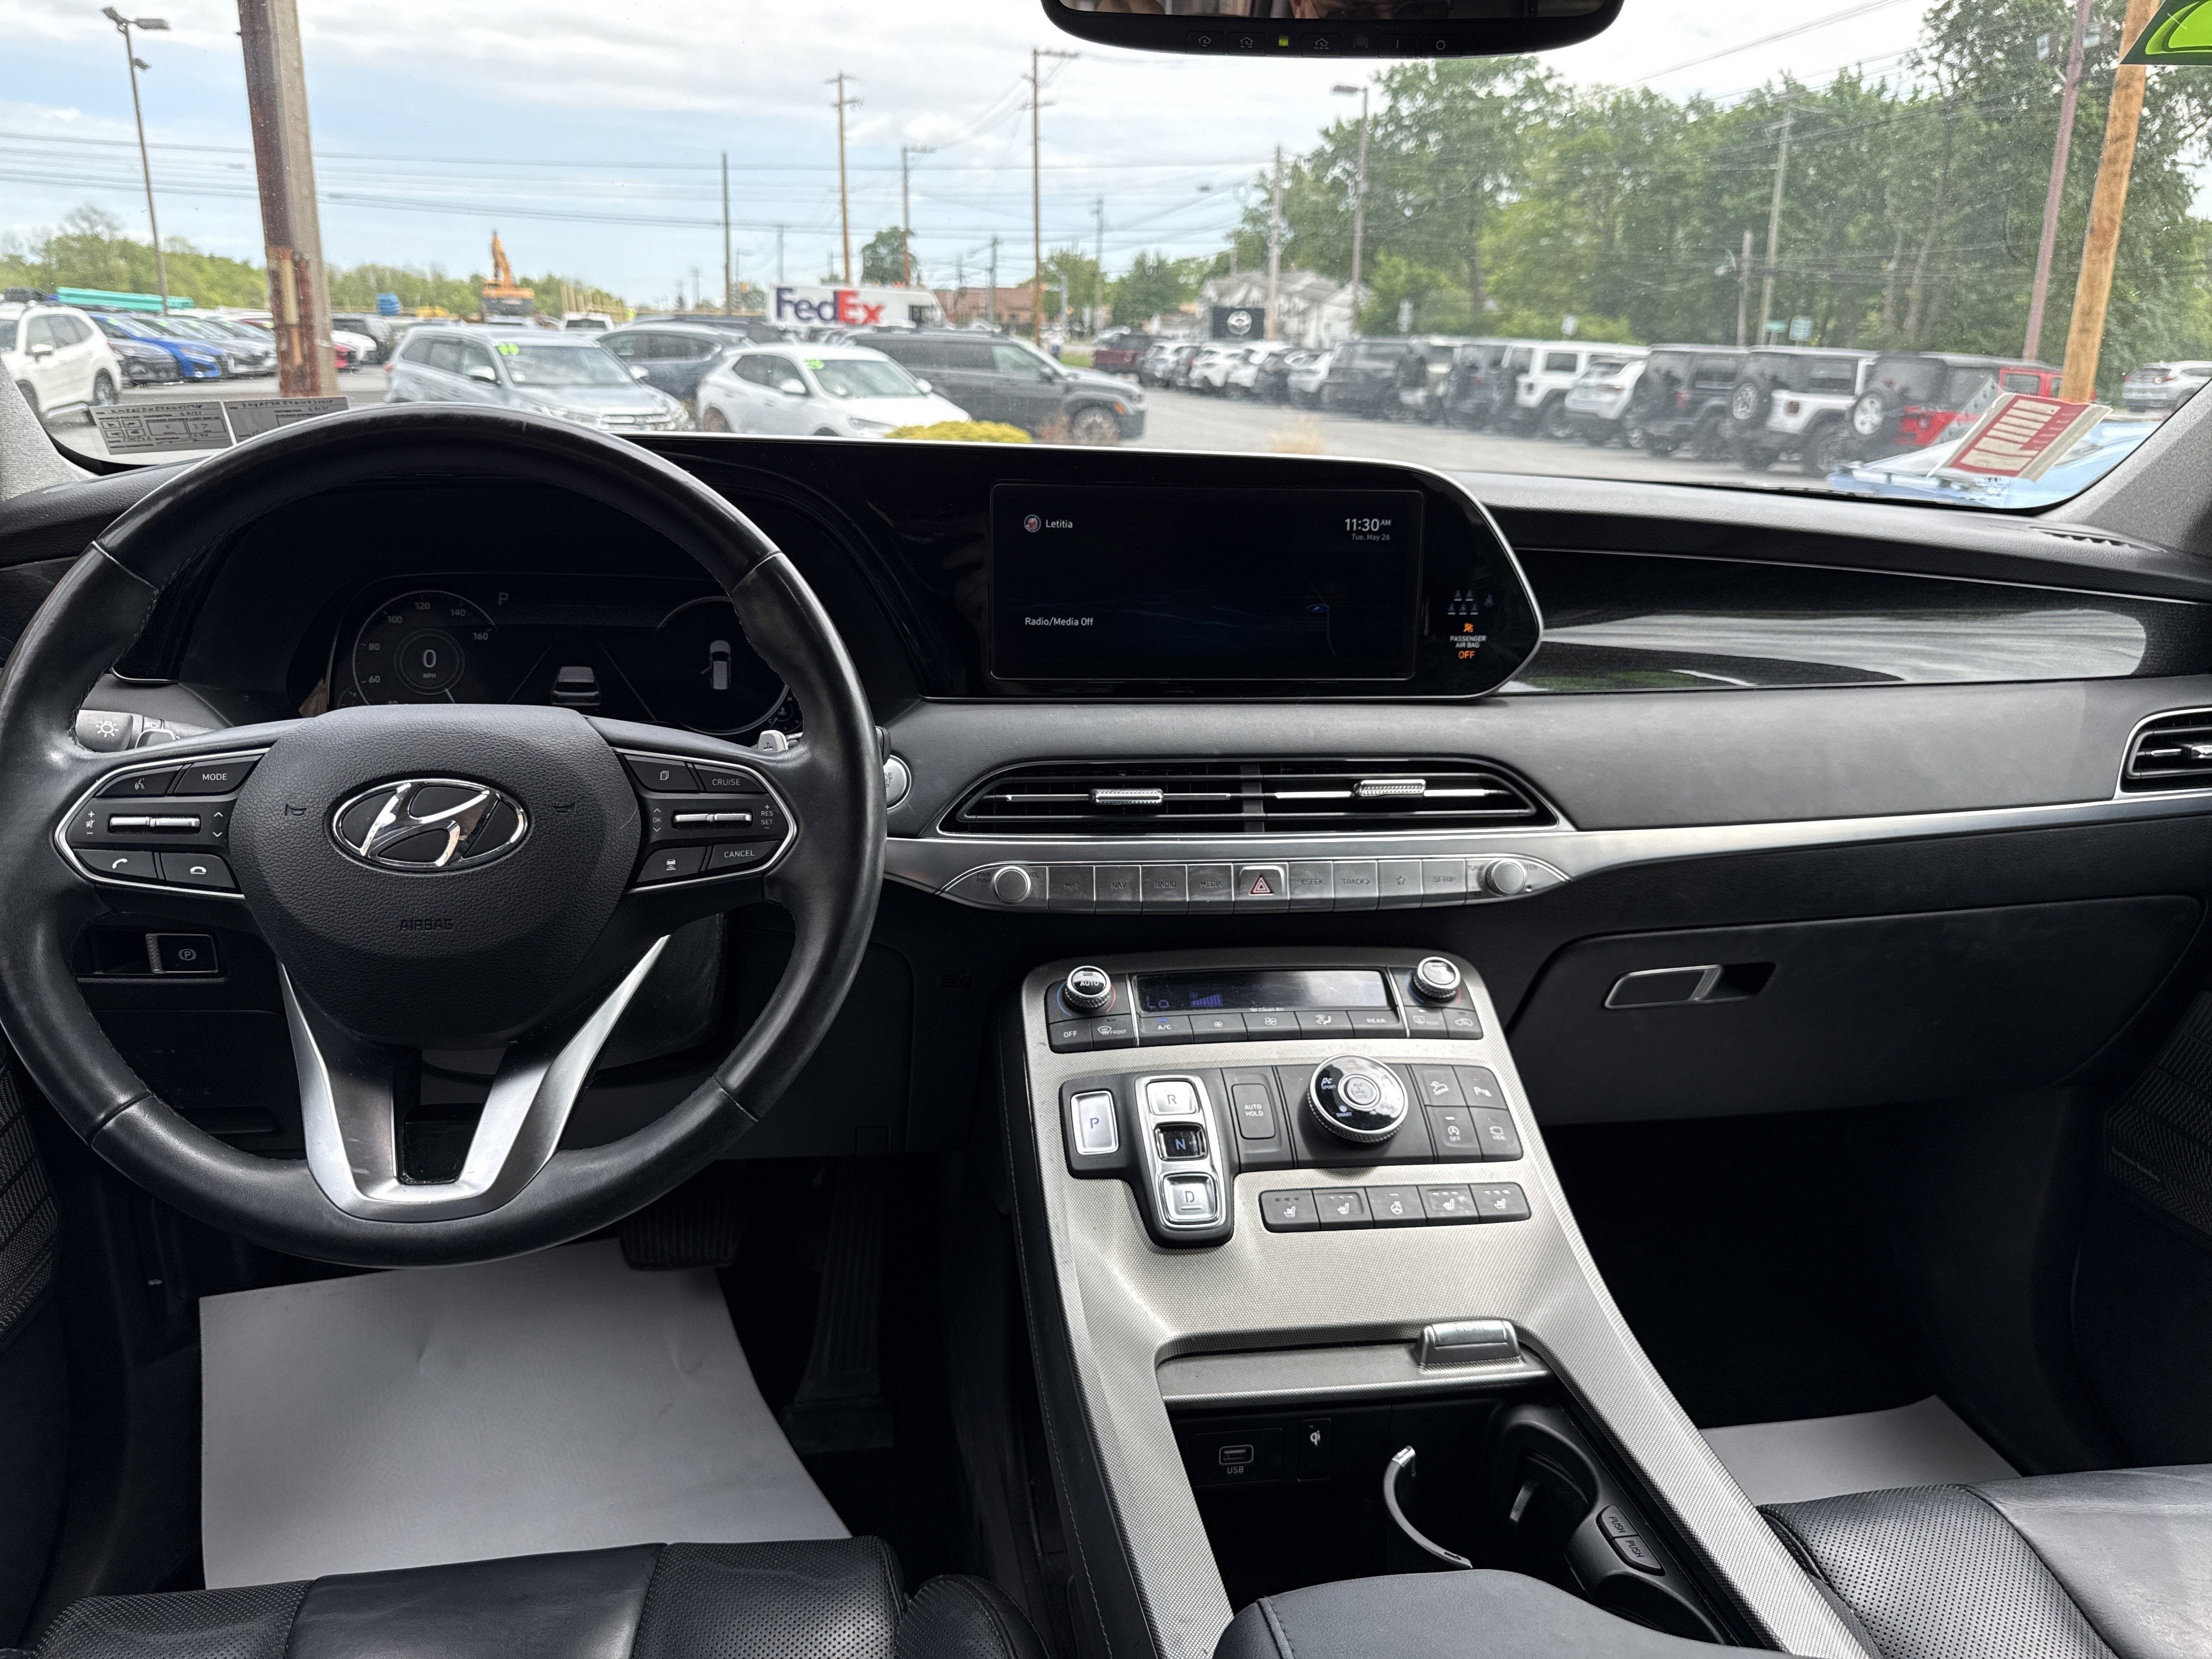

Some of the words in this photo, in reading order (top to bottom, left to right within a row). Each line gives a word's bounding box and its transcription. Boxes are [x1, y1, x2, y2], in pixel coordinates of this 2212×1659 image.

[776, 287, 885, 325] FedEx
[1045, 519, 1073, 528] Letitia
[1345, 518, 1380, 532] 11:30
[1366, 533, 1380, 542] May
[1381, 533, 1391, 541] 26
[498, 591, 509, 606] P
[415, 601, 431, 611] 120
[452, 608, 466, 617] 140
[387, 615, 404, 624] 100
[1025, 616, 1079, 627] Radio/Media
[1081, 617, 1094, 627] Off
[473, 631, 489, 640] 160
[423, 649, 437, 668] 0
[1458, 650, 1476, 659] OFF
[368, 675, 381, 684] 60
[724, 850, 755, 858] CANCEL
[400, 919, 452, 930] AIRBAG
[1063, 1030, 1077, 1038] OFF
[1167, 1094, 1177, 1105] R
[1090, 1118, 1099, 1129] P
[1175, 1138, 1187, 1150] N
[1184, 1190, 1195, 1203] D
[1227, 1465, 1244, 1474] USB
[1609, 1516, 1626, 1533] PUSH
[1626, 1540, 1644, 1558] PUSH
